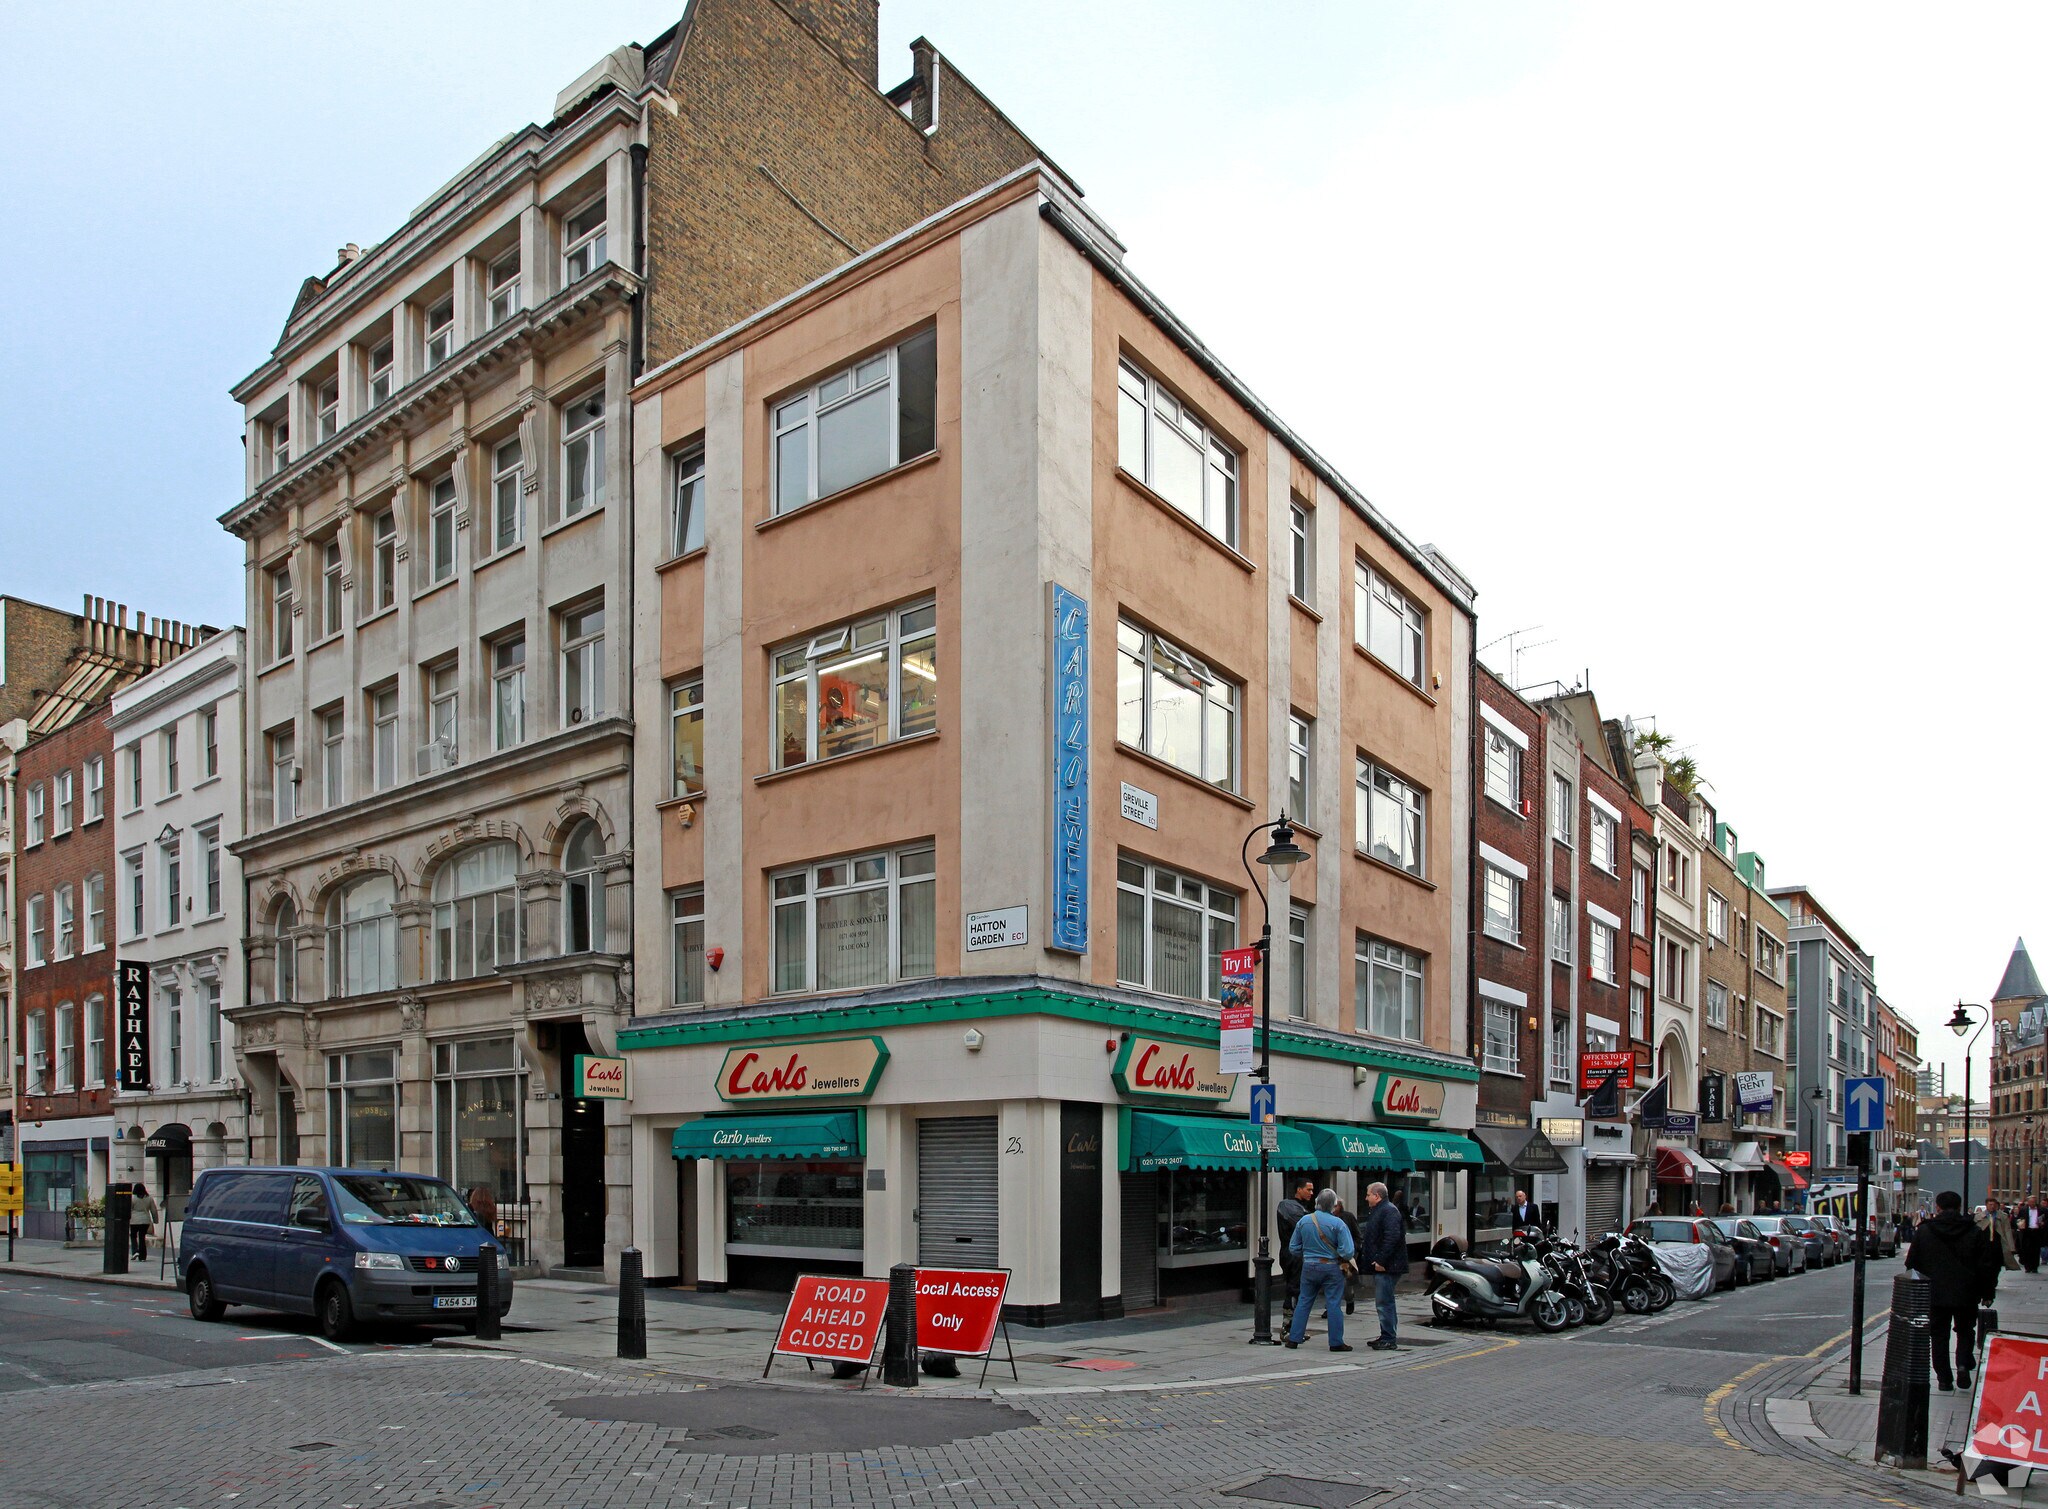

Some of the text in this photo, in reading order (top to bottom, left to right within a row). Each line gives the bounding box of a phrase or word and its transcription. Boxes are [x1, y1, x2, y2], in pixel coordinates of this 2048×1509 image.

[1062, 607, 1084, 787] CARLO
[1123, 792, 1149, 810] GREVILLE
[1123, 804, 1156, 825] STREET EC1
[970, 920, 1006, 934] HATTON
[970, 932, 1024, 946] GARDEN EC1
[1223, 956, 1252, 973] Try it
[126, 967, 143, 1084] RAPHAEL
[587, 1062, 622, 1081] Carlo
[729, 1053, 859, 1095] Carlo Jewellers
[1135, 1044, 1195, 1090] Carlo
[1197, 1081, 1228, 1094] Jewellers
[1738, 1073, 1758, 1083] FOR
[589, 1085, 620, 1093] Jewellers
[1740, 1079, 1765, 1091] RENT
[1387, 1079, 1438, 1115] Carlo Jewellers
[713, 1130, 772, 1146] Carlo Jewellers
[1067, 1132, 1099, 1153] Carlo
[1223, 1132, 1253, 1152] Carlo
[1342, 1136, 1386, 1155] Carlo Jewellers
[1430, 1143, 1463, 1160] Carlo Jewellers
[1155, 1157, 1168, 1165] 7242
[814, 1285, 866, 1303] ROAD
[914, 1280, 1000, 1297] Local Access
[439, 1297, 477, 1306] EX54 SJY
[801, 1307, 866, 1326] AHEAD
[932, 1313, 964, 1332] Only
[789, 1329, 864, 1351] CLOSED
